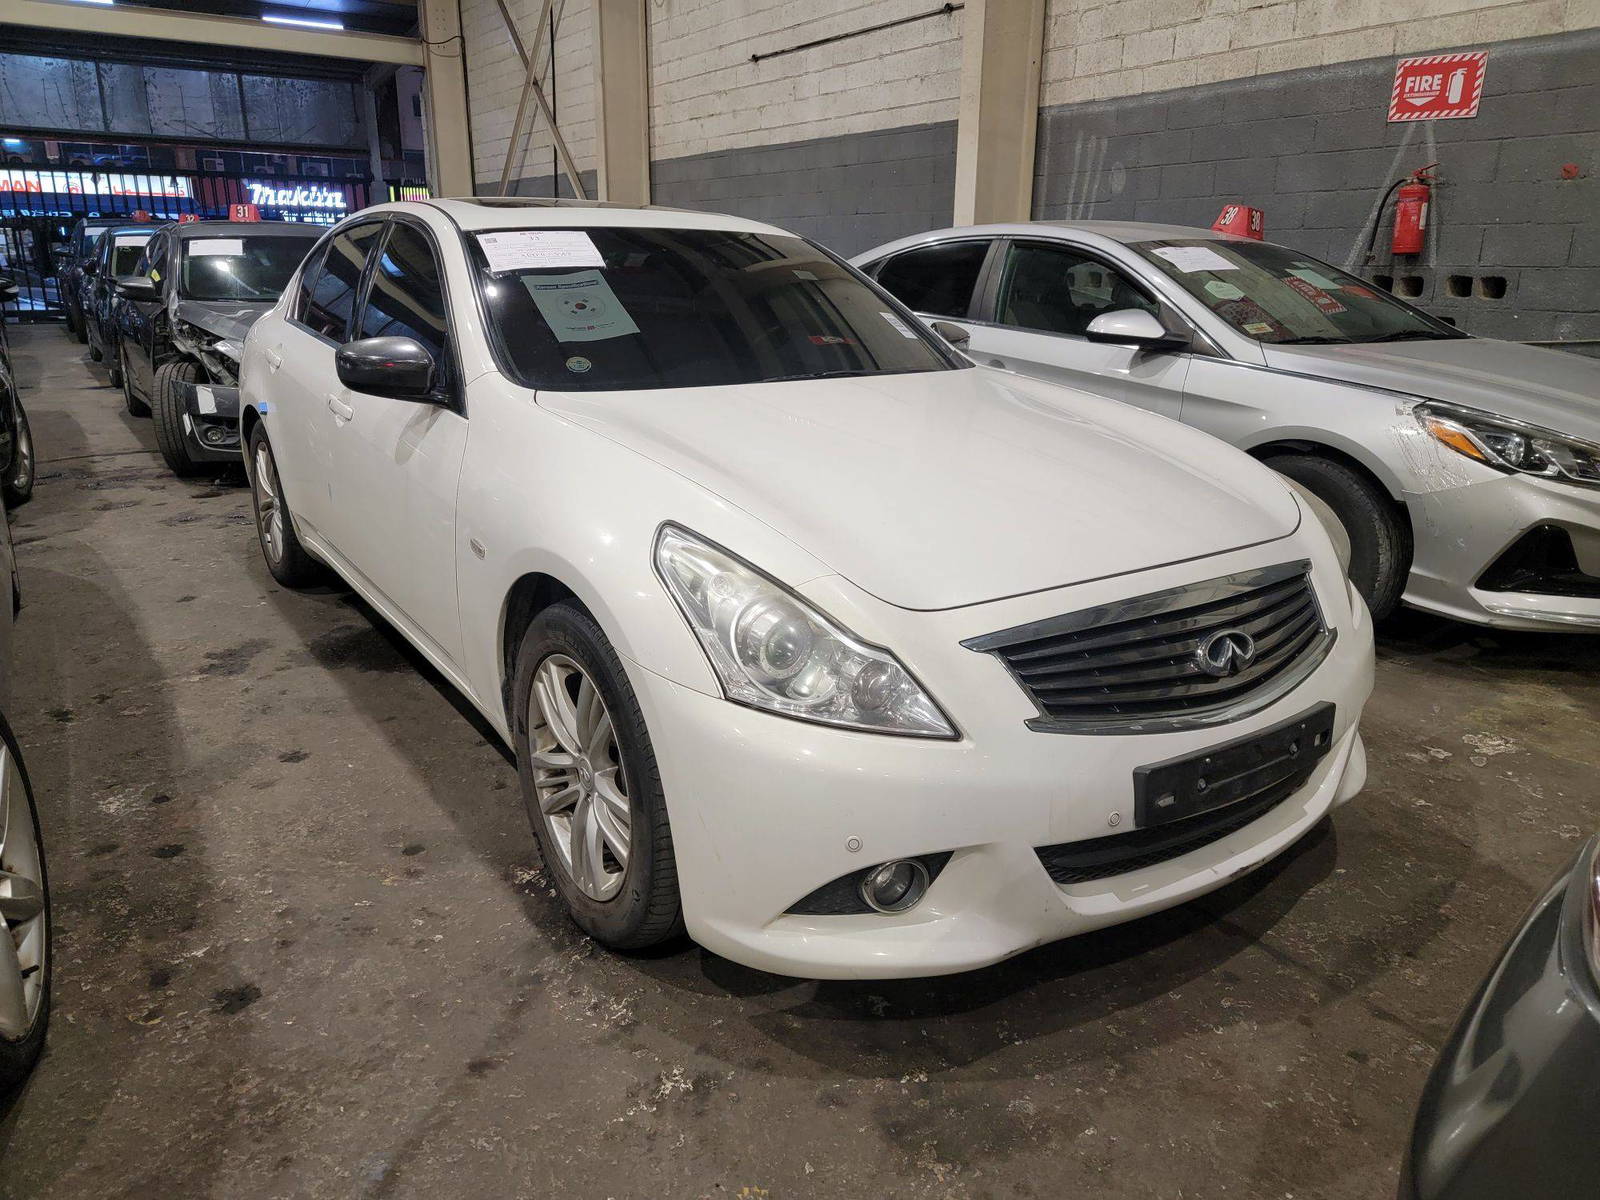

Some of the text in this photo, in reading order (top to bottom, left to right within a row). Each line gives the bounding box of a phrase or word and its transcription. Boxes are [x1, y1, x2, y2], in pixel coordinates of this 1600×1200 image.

[1404, 74, 1443, 92] FIRE
[247, 183, 347, 208] Makita
[185, 215, 195, 223] 32
[236, 205, 249, 218] 31
[1220, 206, 1239, 225] 38
[1251, 209, 1261, 231] 38
